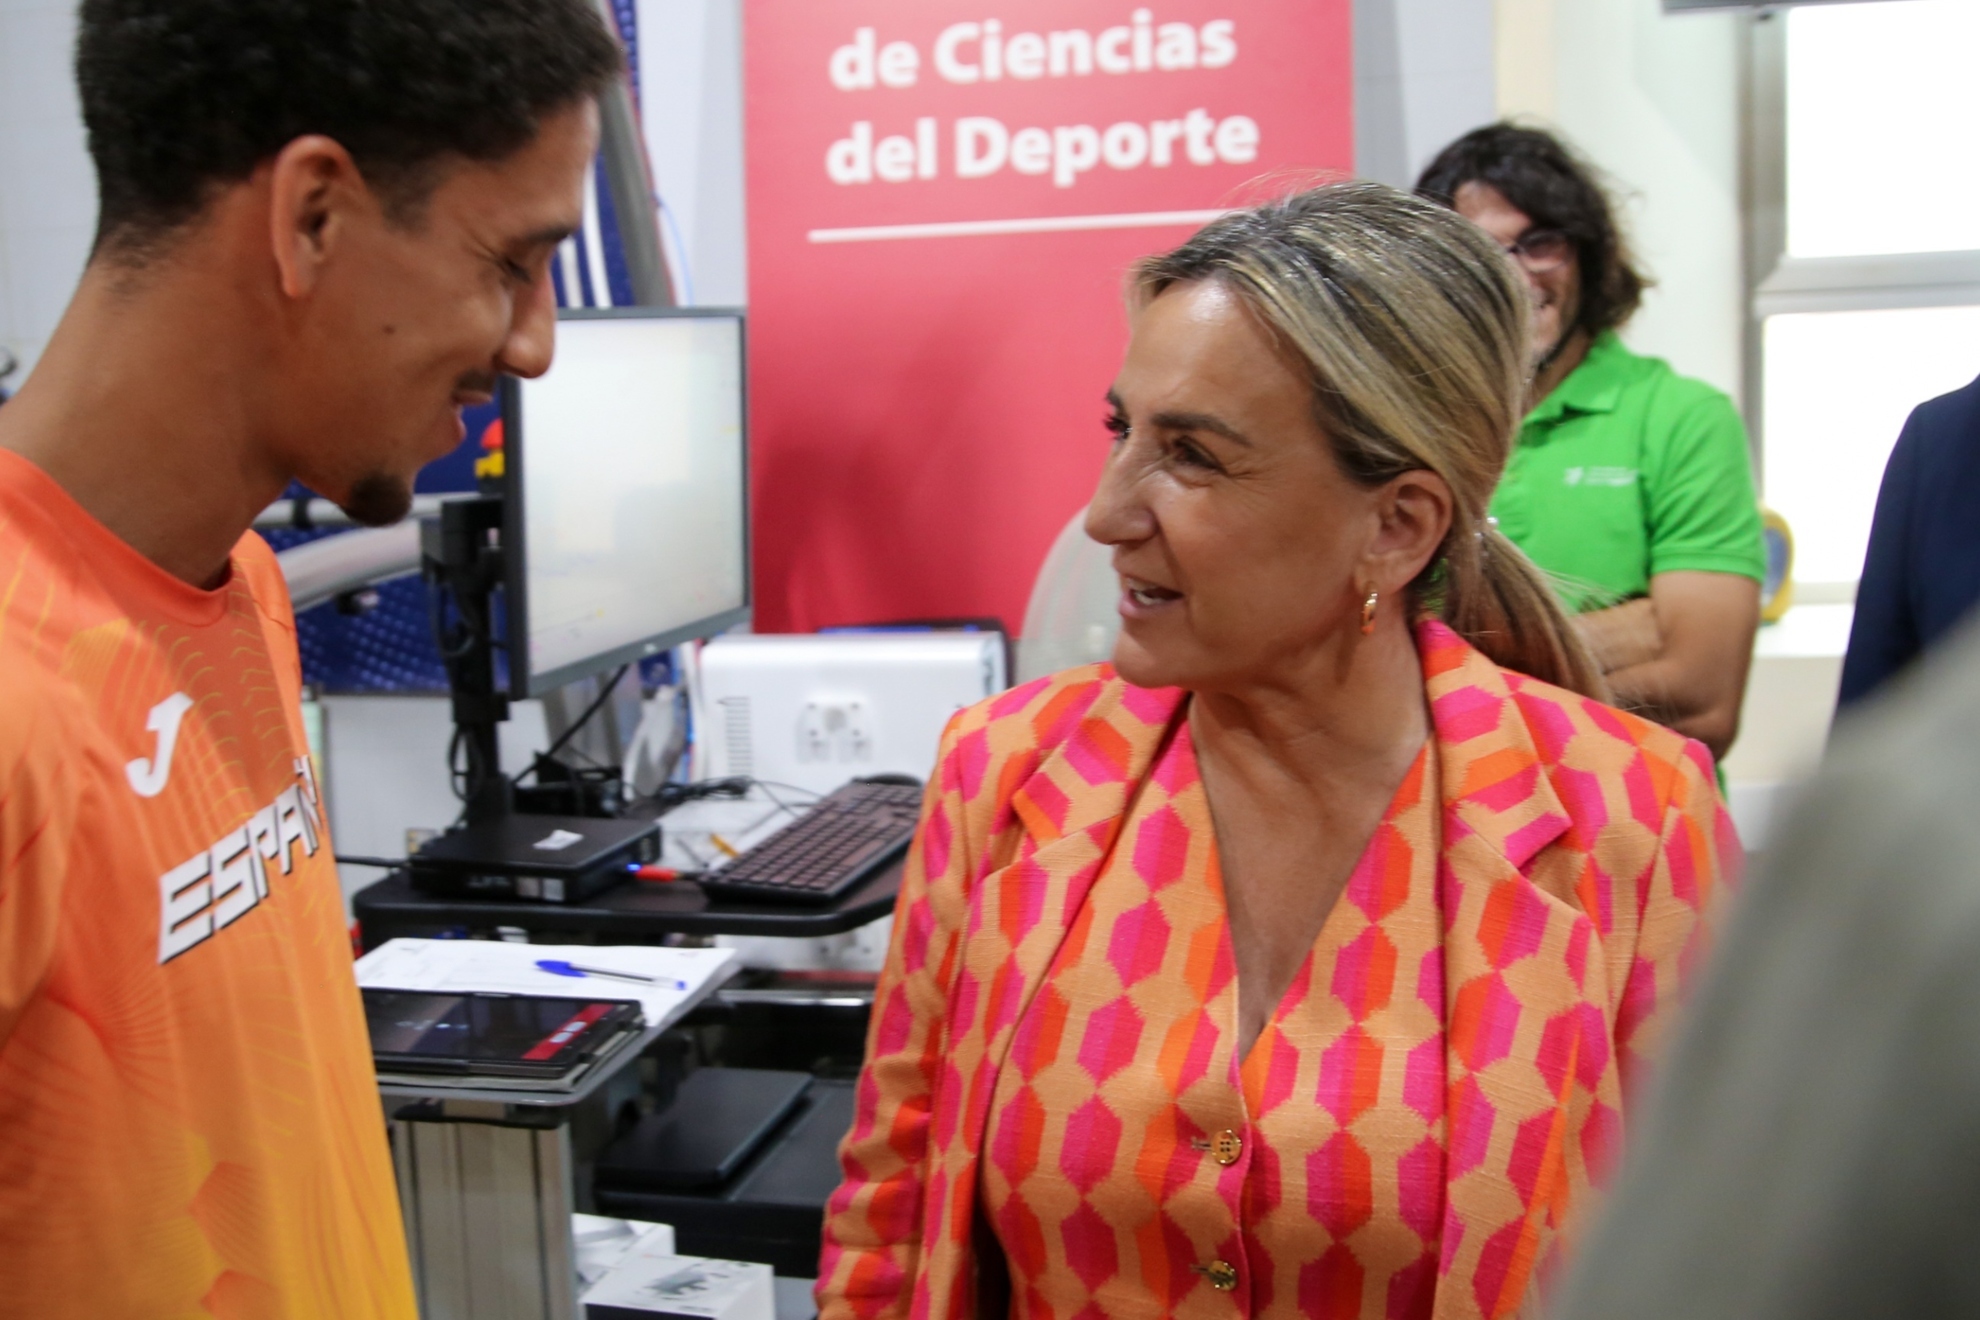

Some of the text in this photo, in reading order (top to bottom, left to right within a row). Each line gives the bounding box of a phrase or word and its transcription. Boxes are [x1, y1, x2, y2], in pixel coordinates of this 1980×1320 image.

[829, 8, 1238, 91] de Ciencias
[825, 108, 1261, 188] del Deporte
